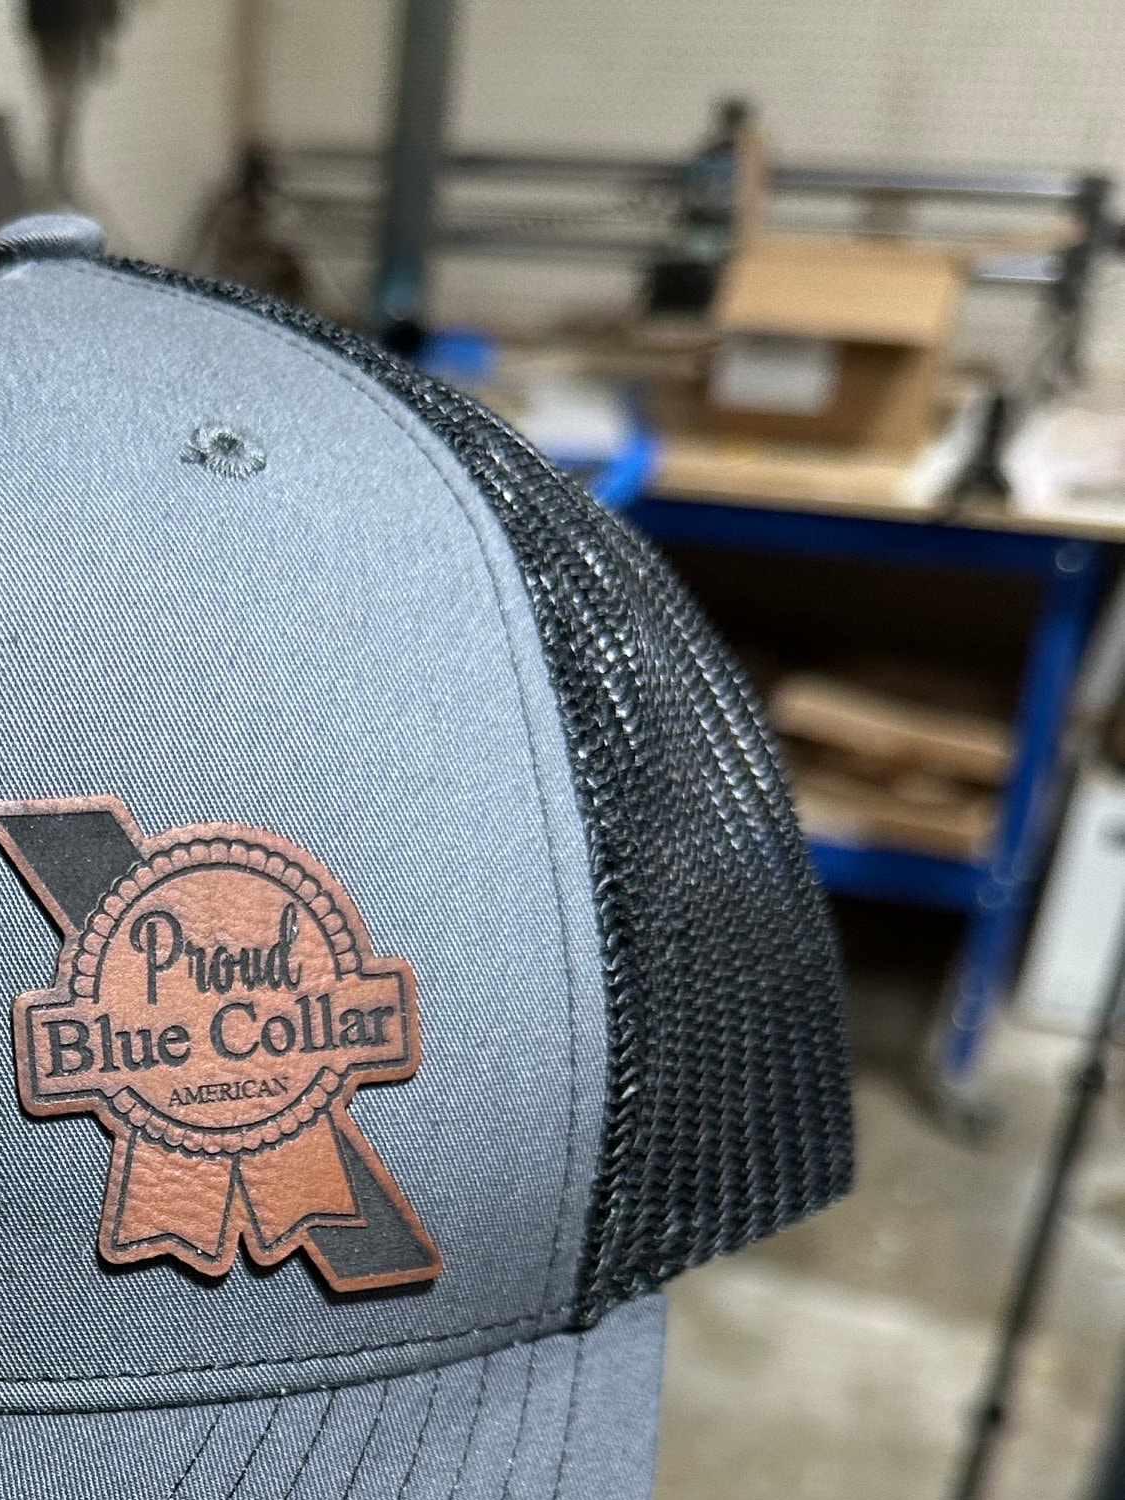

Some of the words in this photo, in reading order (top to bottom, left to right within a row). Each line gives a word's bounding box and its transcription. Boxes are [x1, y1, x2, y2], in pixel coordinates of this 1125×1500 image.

[130, 902, 303, 1004] Proud
[42, 1013, 192, 1079] Blue
[210, 993, 395, 1062] Collar
[169, 1076, 290, 1108] AMERICAN
